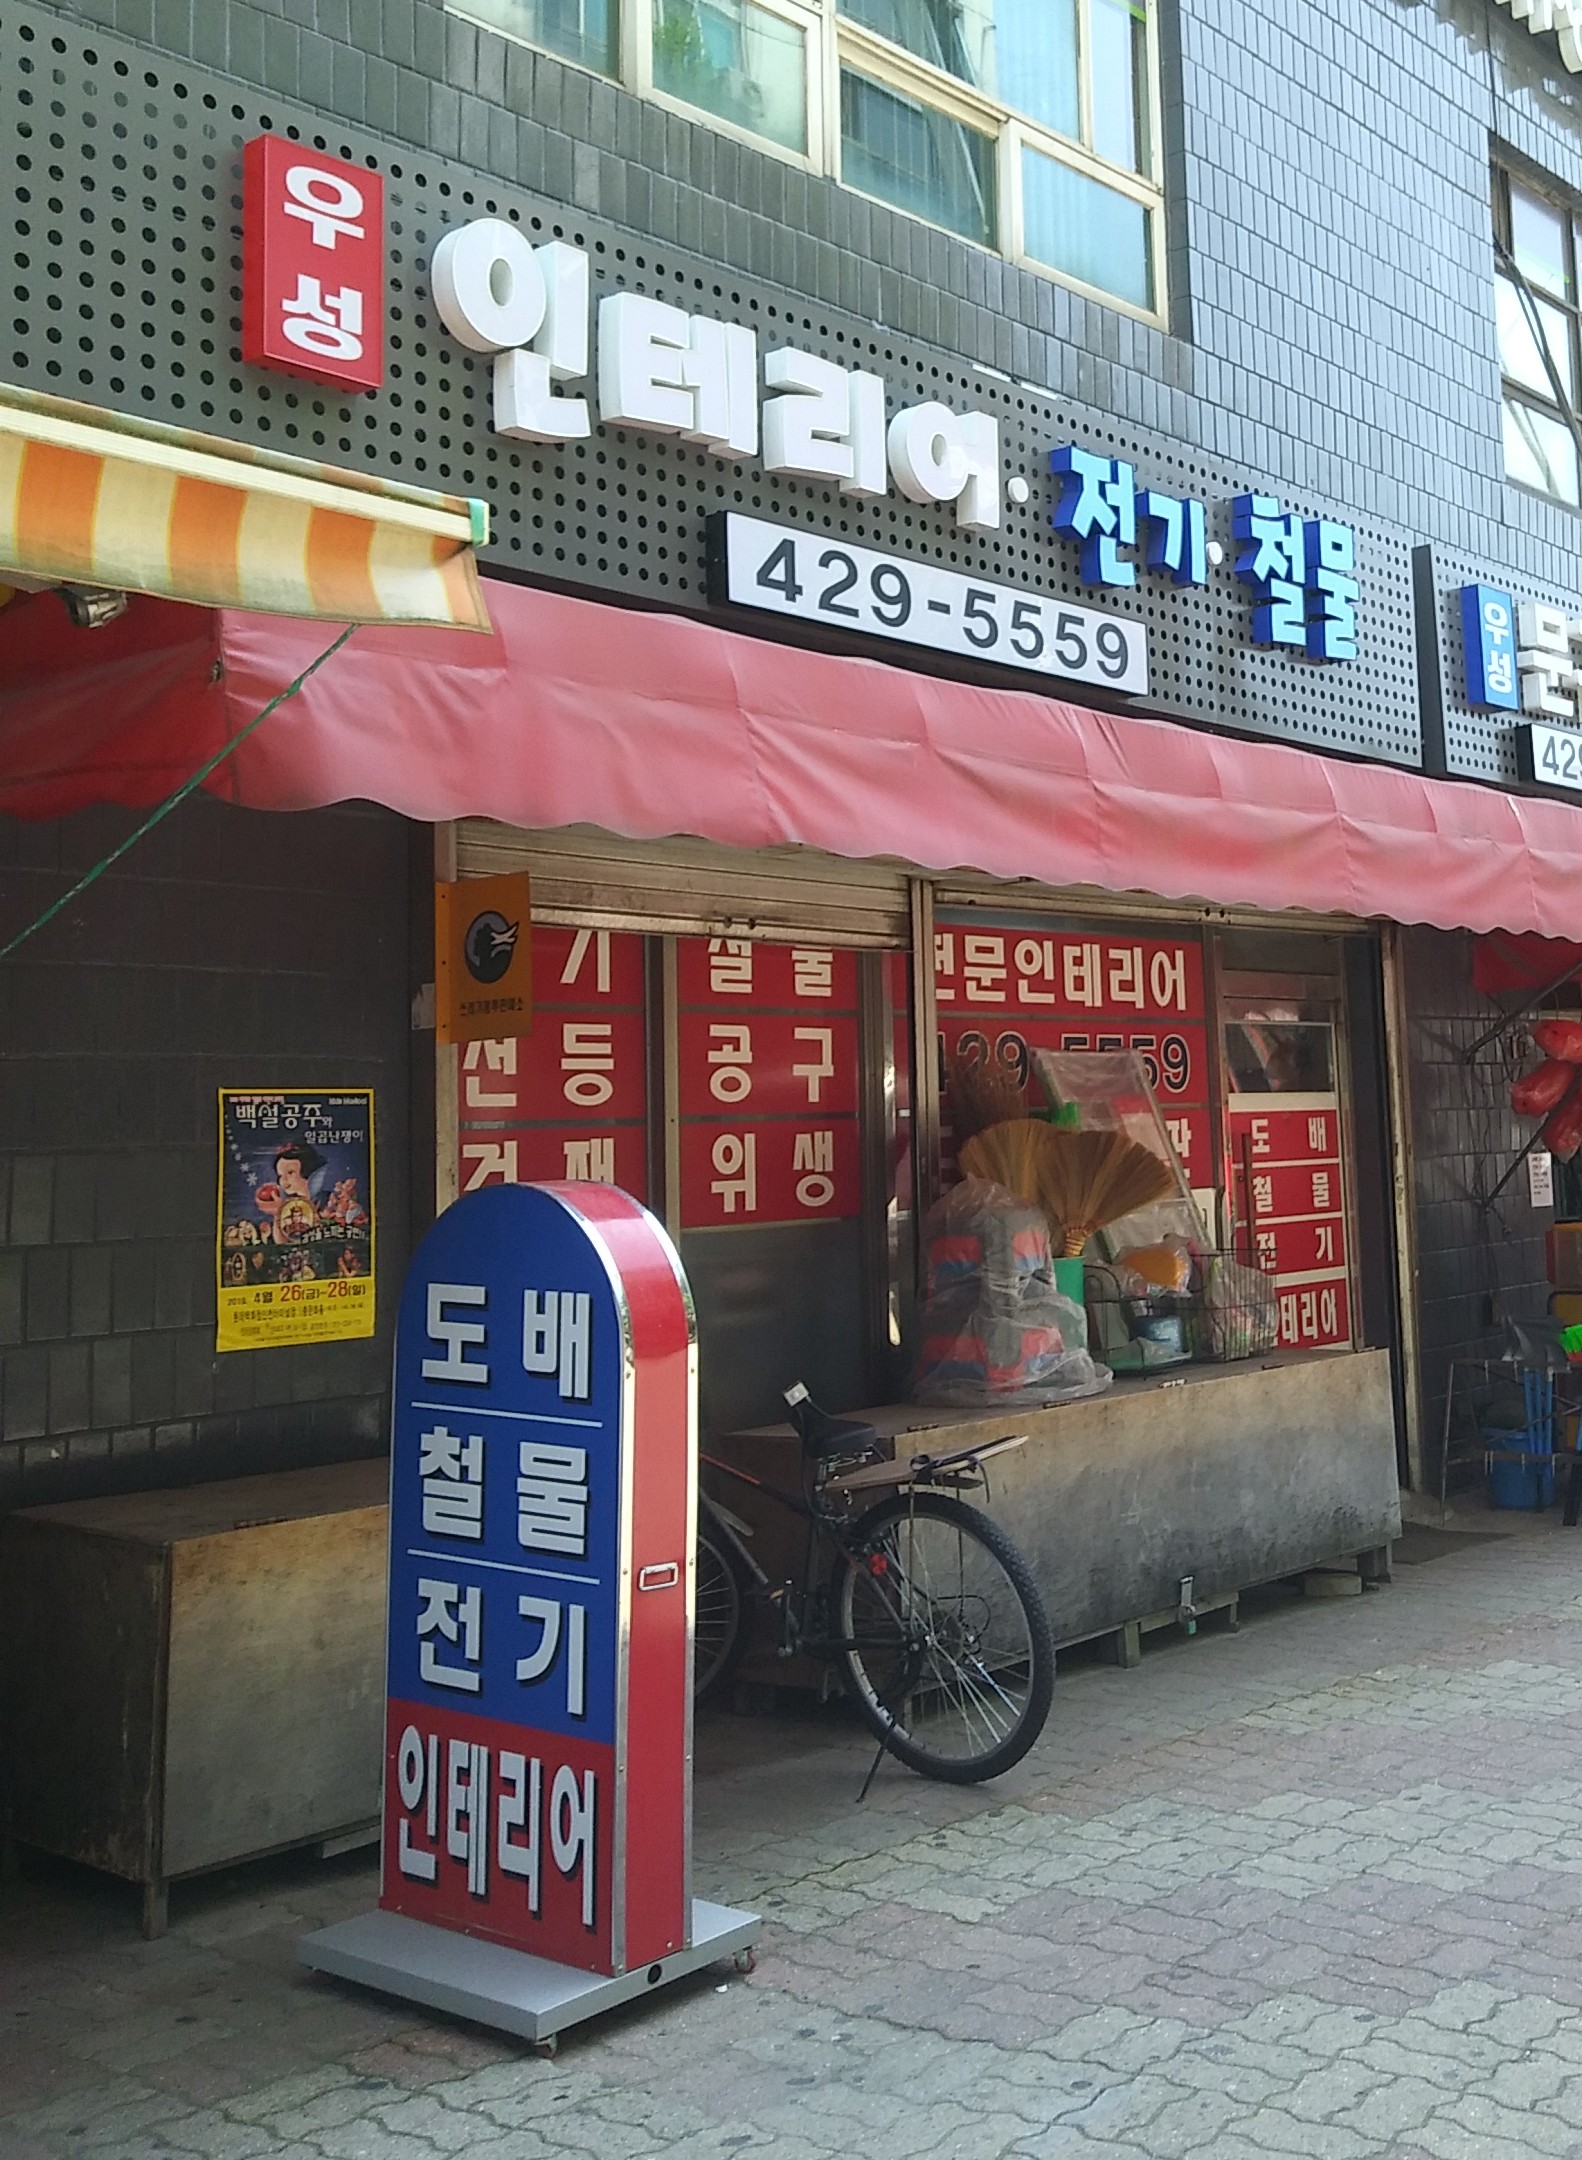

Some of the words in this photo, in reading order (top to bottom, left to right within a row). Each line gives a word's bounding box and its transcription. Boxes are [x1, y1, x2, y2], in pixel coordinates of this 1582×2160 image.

[282, 165, 365, 360] 우성
[432, 217, 1000, 532] 인테리어
[1050, 445, 1206, 589] 전기
[1232, 493, 1360, 662] 철물
[756, 538, 1129, 679] 429-5559
[1484, 602, 1513, 694] 우성
[1517, 602, 1582, 719] 문
[1542, 735, 1582, 782] 42
[421, 1282, 590, 1400] 도배
[1272, 1288, 1338, 1348] 테리어
[418, 1425, 588, 1555] 철물
[416, 1577, 585, 1716] 전기
[397, 1724, 596, 1927] 인테리어
